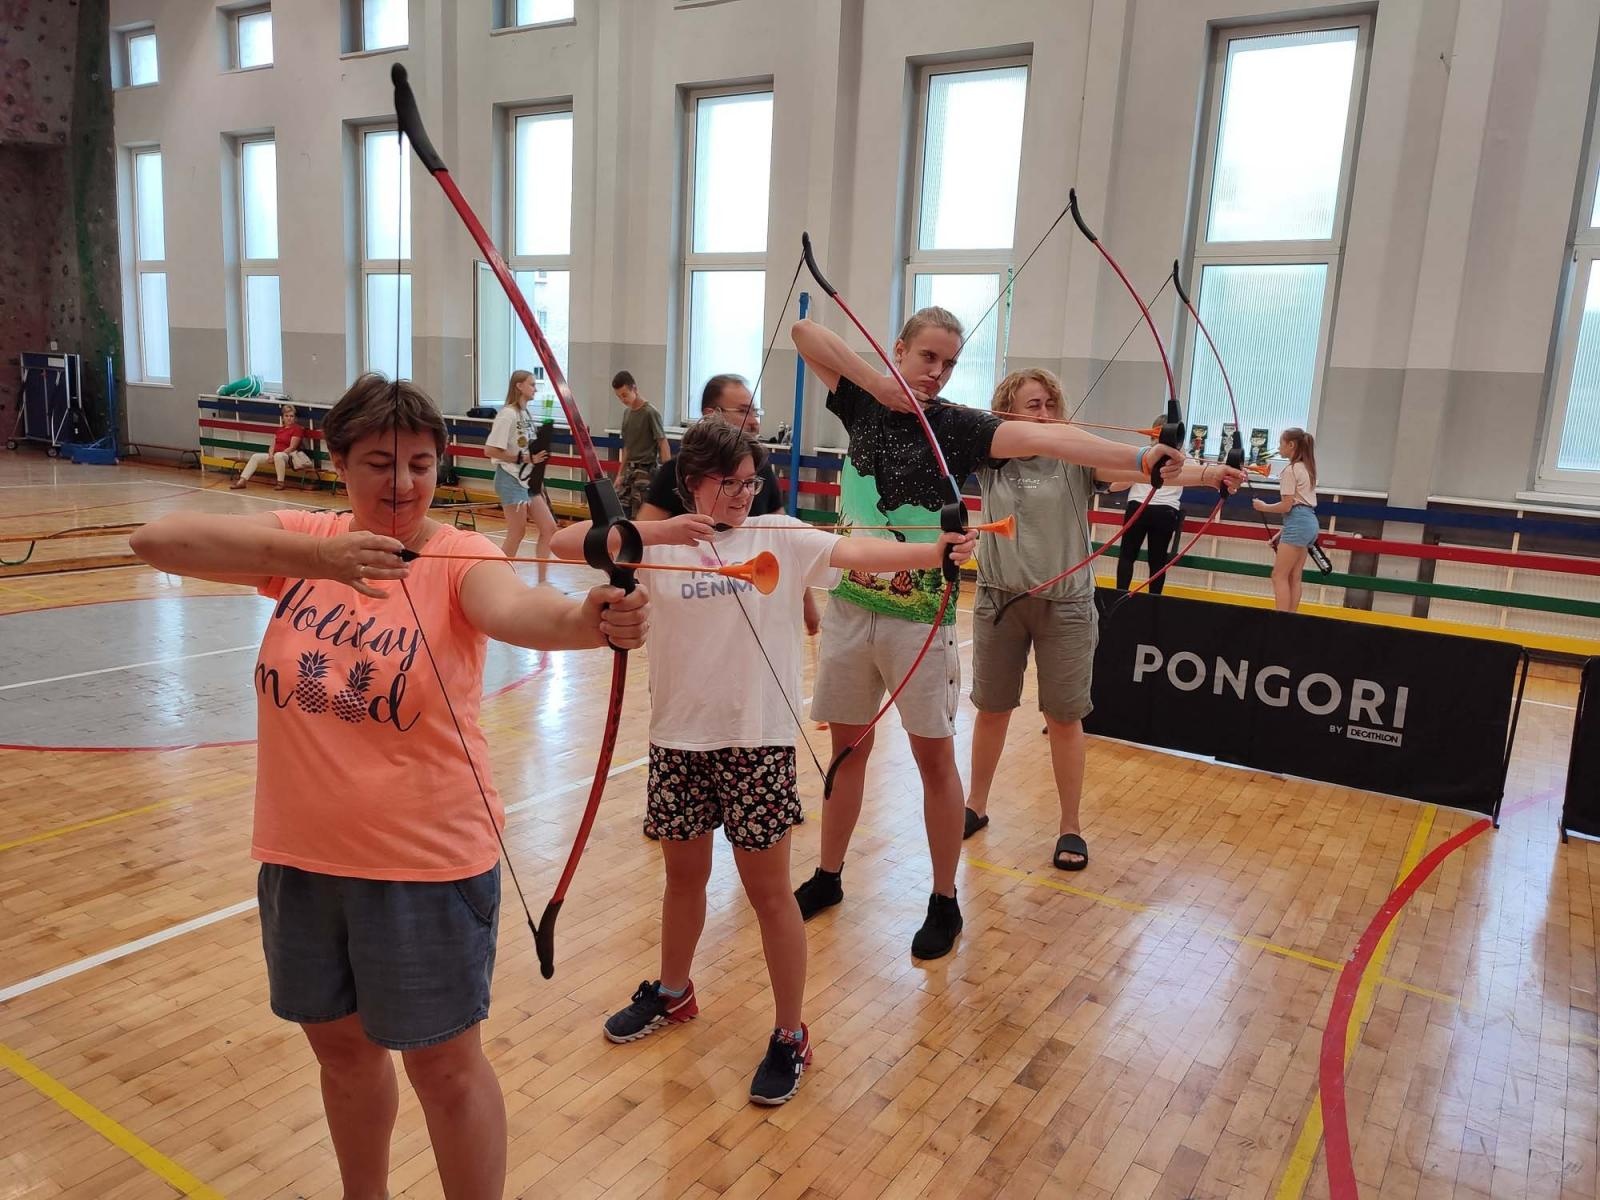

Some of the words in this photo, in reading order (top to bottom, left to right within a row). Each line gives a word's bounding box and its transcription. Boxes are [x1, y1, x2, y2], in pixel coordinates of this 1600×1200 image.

[681, 580, 753, 599] DENIM
[274, 578, 422, 672] Holiday
[1132, 643, 1409, 728] PONGORI
[1329, 724, 1343, 734] BY
[1350, 728, 1399, 743] DECATHLON
